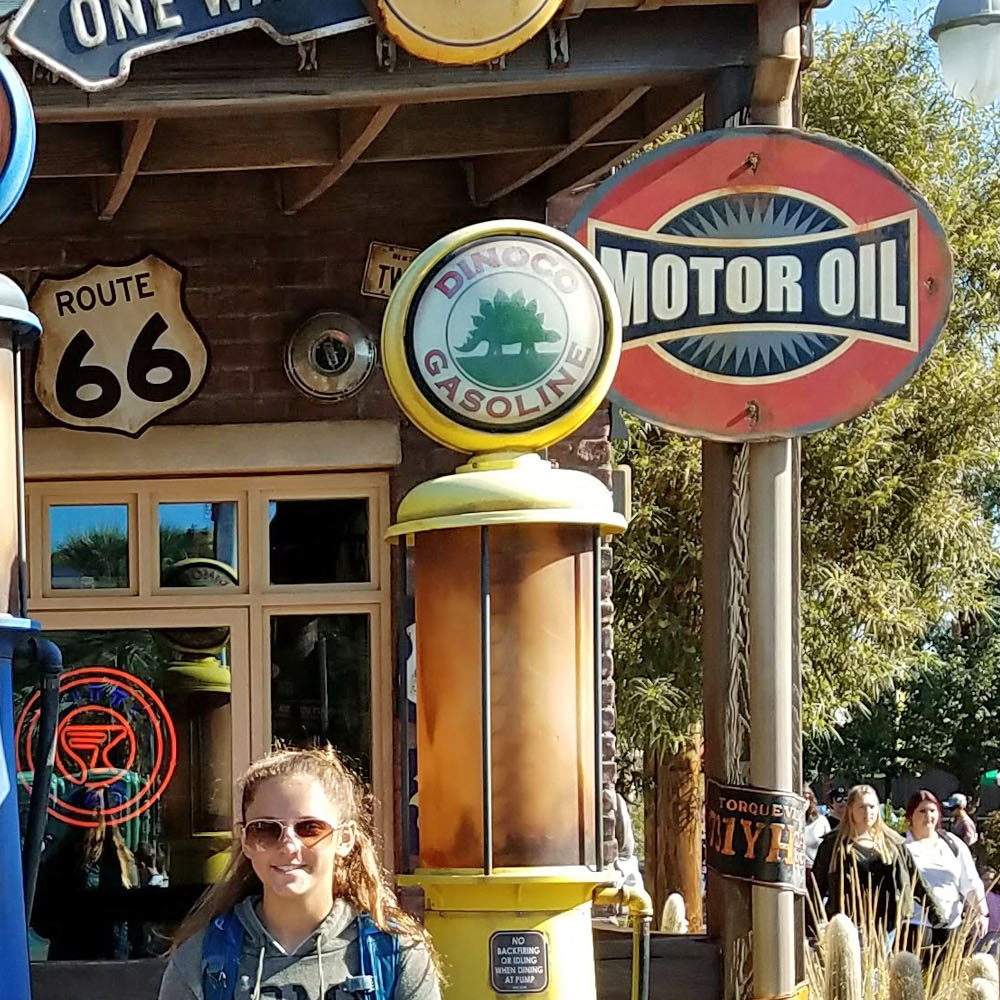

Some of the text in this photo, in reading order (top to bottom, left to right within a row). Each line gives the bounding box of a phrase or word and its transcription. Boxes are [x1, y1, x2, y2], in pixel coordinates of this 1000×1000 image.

[434, 246, 579, 300] DINOCO
[600, 239, 906, 327] MOTOR OIL
[55, 272, 155, 317] ROUTE
[55, 312, 192, 419] 66
[424, 342, 592, 418] GASOLINE
[497, 946, 540, 955] BACKFIRING
[511, 936, 526, 945] NO
[494, 966, 516, 974] WHEN
[500, 956, 538, 964] OR IDLING
[504, 975, 535, 983] AT PUMP
